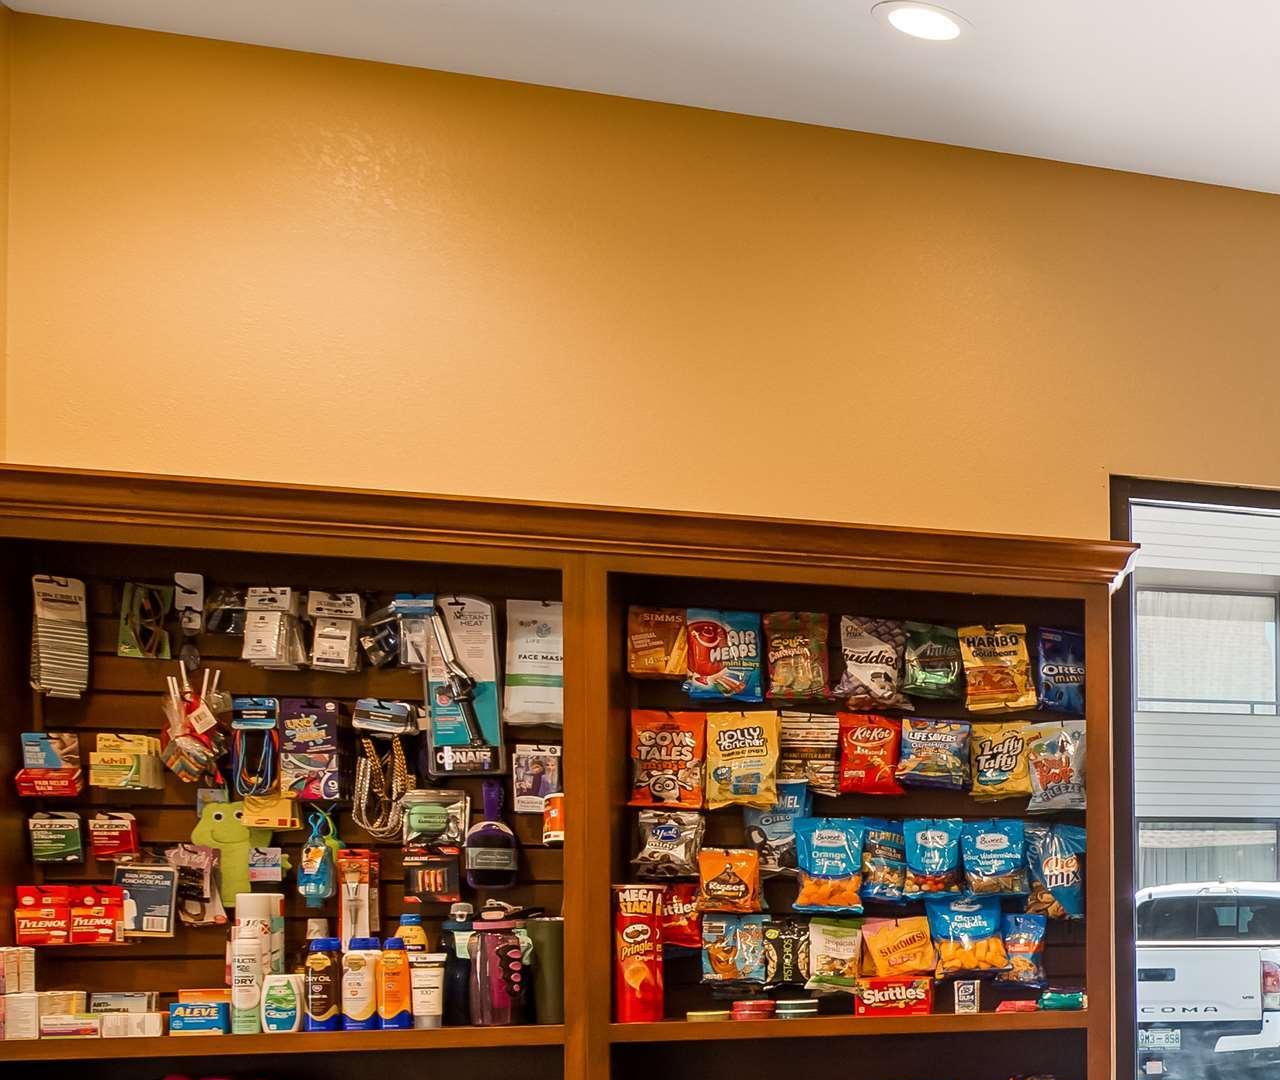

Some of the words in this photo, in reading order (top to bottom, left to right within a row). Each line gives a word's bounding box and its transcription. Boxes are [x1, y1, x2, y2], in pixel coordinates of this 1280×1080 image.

[643, 613, 682, 622] SIMMS
[727, 630, 756, 645] AIR
[966, 634, 1019, 648] HARIBO
[709, 644, 758, 662] HEADS
[971, 650, 1018, 659] Goldbears
[638, 730, 694, 747] COW
[717, 726, 762, 741] JOLLY
[908, 731, 928, 741] LIFE
[927, 732, 958, 743] SAVERS
[980, 735, 1025, 756] Laffy
[436, 751, 491, 764] CONAIR
[637, 745, 694, 761] TALES
[99, 757, 127, 765] Advil
[975, 753, 1018, 771] Taffy
[1039, 782, 1083, 802] FREEZE
[811, 850, 847, 860] Orange
[1046, 870, 1081, 889] mix
[619, 889, 654, 902] MEGA
[619, 901, 653, 914] STACK
[18, 919, 68, 929] TYLENOL
[73, 917, 114, 927] TYLENOL
[879, 931, 928, 958] Starburst
[861, 985, 926, 1005] Skittles
[172, 1007, 219, 1017] ALEVE
[1140, 1006, 1219, 1014] COMA
